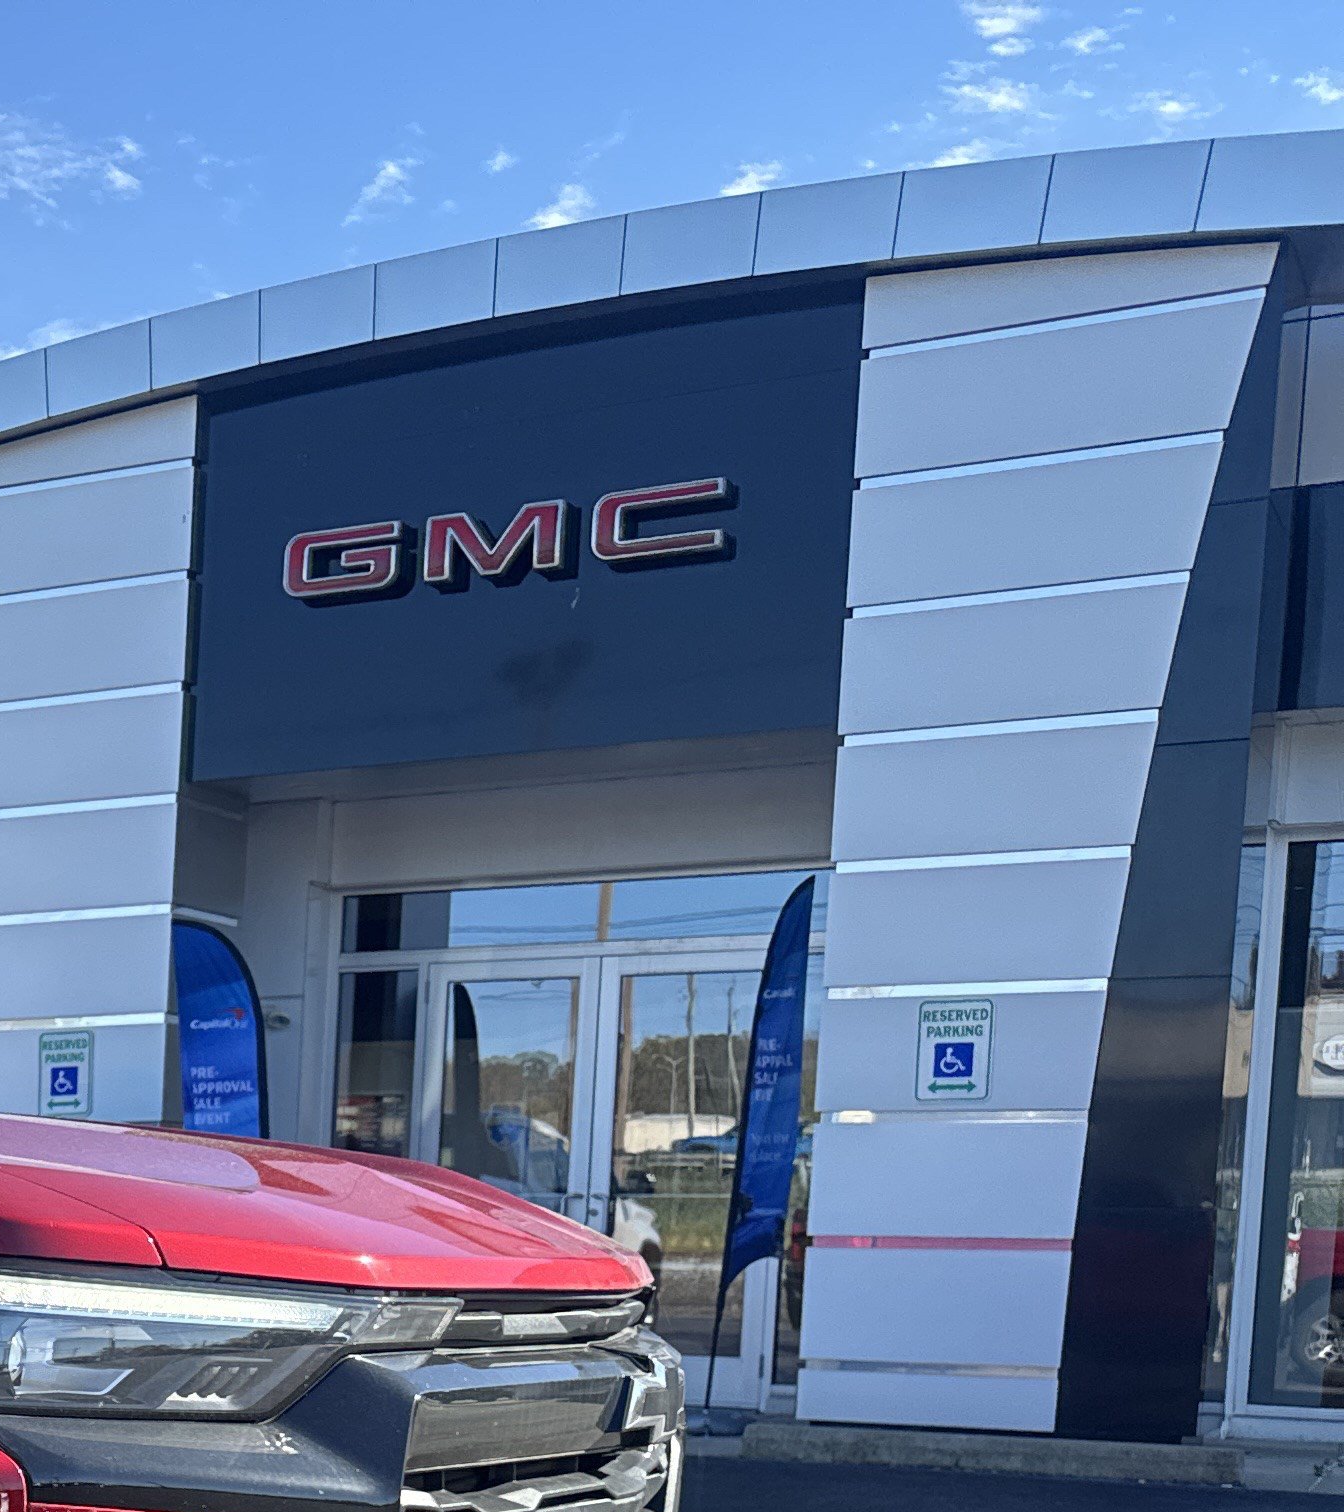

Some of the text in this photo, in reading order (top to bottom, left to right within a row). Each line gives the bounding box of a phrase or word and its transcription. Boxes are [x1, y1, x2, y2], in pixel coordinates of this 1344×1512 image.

[282, 476, 730, 599] GMC
[923, 1008, 989, 1022] RESERVED
[926, 1024, 984, 1038] PARKING
[41, 1038, 88, 1050] RESERVED
[44, 1052, 85, 1063] PARKING
[192, 1080, 254, 1095] APPROVAL
[193, 1097, 221, 1110] SALE
